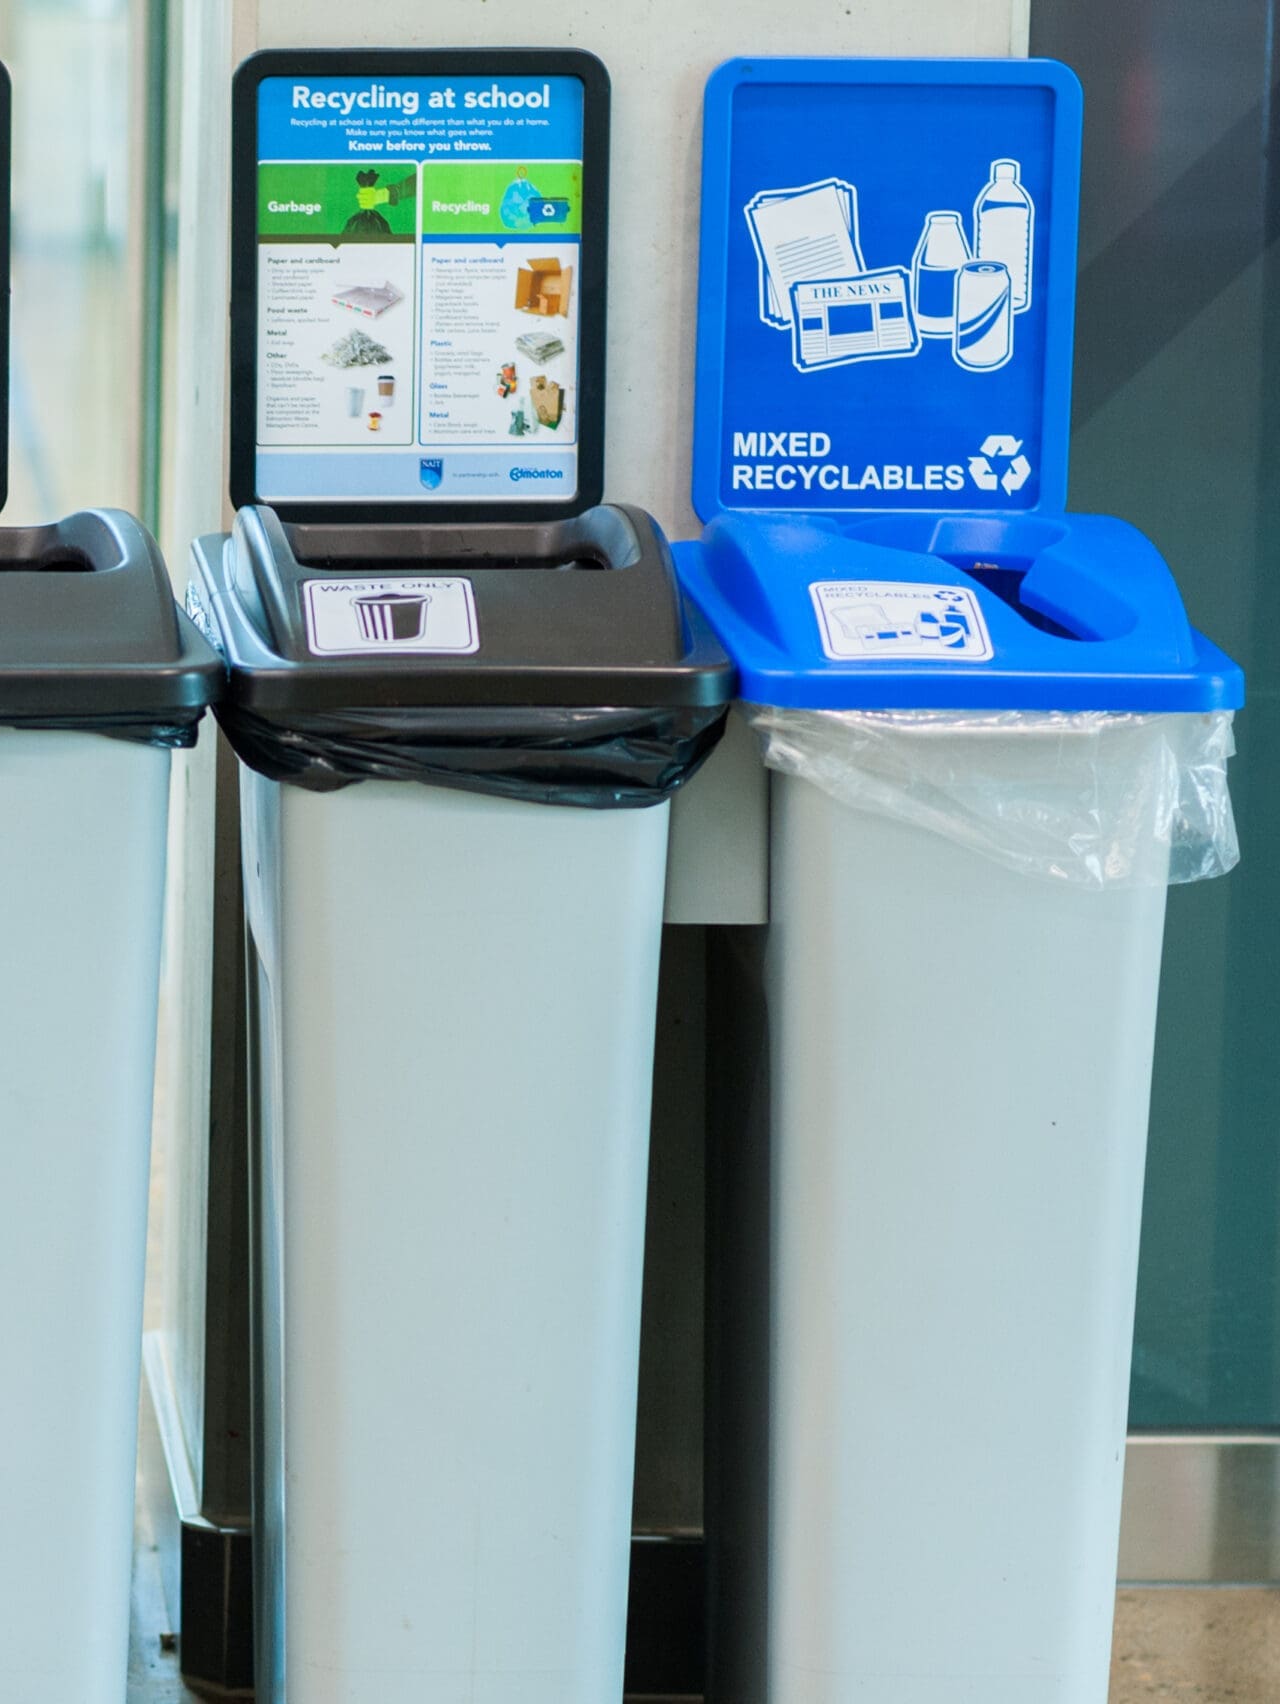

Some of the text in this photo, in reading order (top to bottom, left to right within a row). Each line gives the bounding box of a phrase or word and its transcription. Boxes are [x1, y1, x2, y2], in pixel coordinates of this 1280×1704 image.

[292, 84, 550, 115] Recycling at school
[290, 118, 328, 127] Recycling
[389, 118, 410, 126] much
[412, 118, 445, 126] different
[447, 118, 465, 126] than
[345, 128, 368, 136] Make
[447, 130, 467, 138] goes
[468, 128, 493, 136] where.
[348, 140, 492, 153] Know before you throw.
[268, 201, 321, 215] Garbage
[432, 200, 490, 214] Recycling
[813, 283, 891, 299] THE NEWS
[733, 432, 831, 457] MIXED
[509, 467, 563, 481] Edmonton
[733, 465, 964, 490] RECYCLABLES
[321, 584, 392, 592] WASTE
[825, 592, 932, 600] RECYCLABLES
